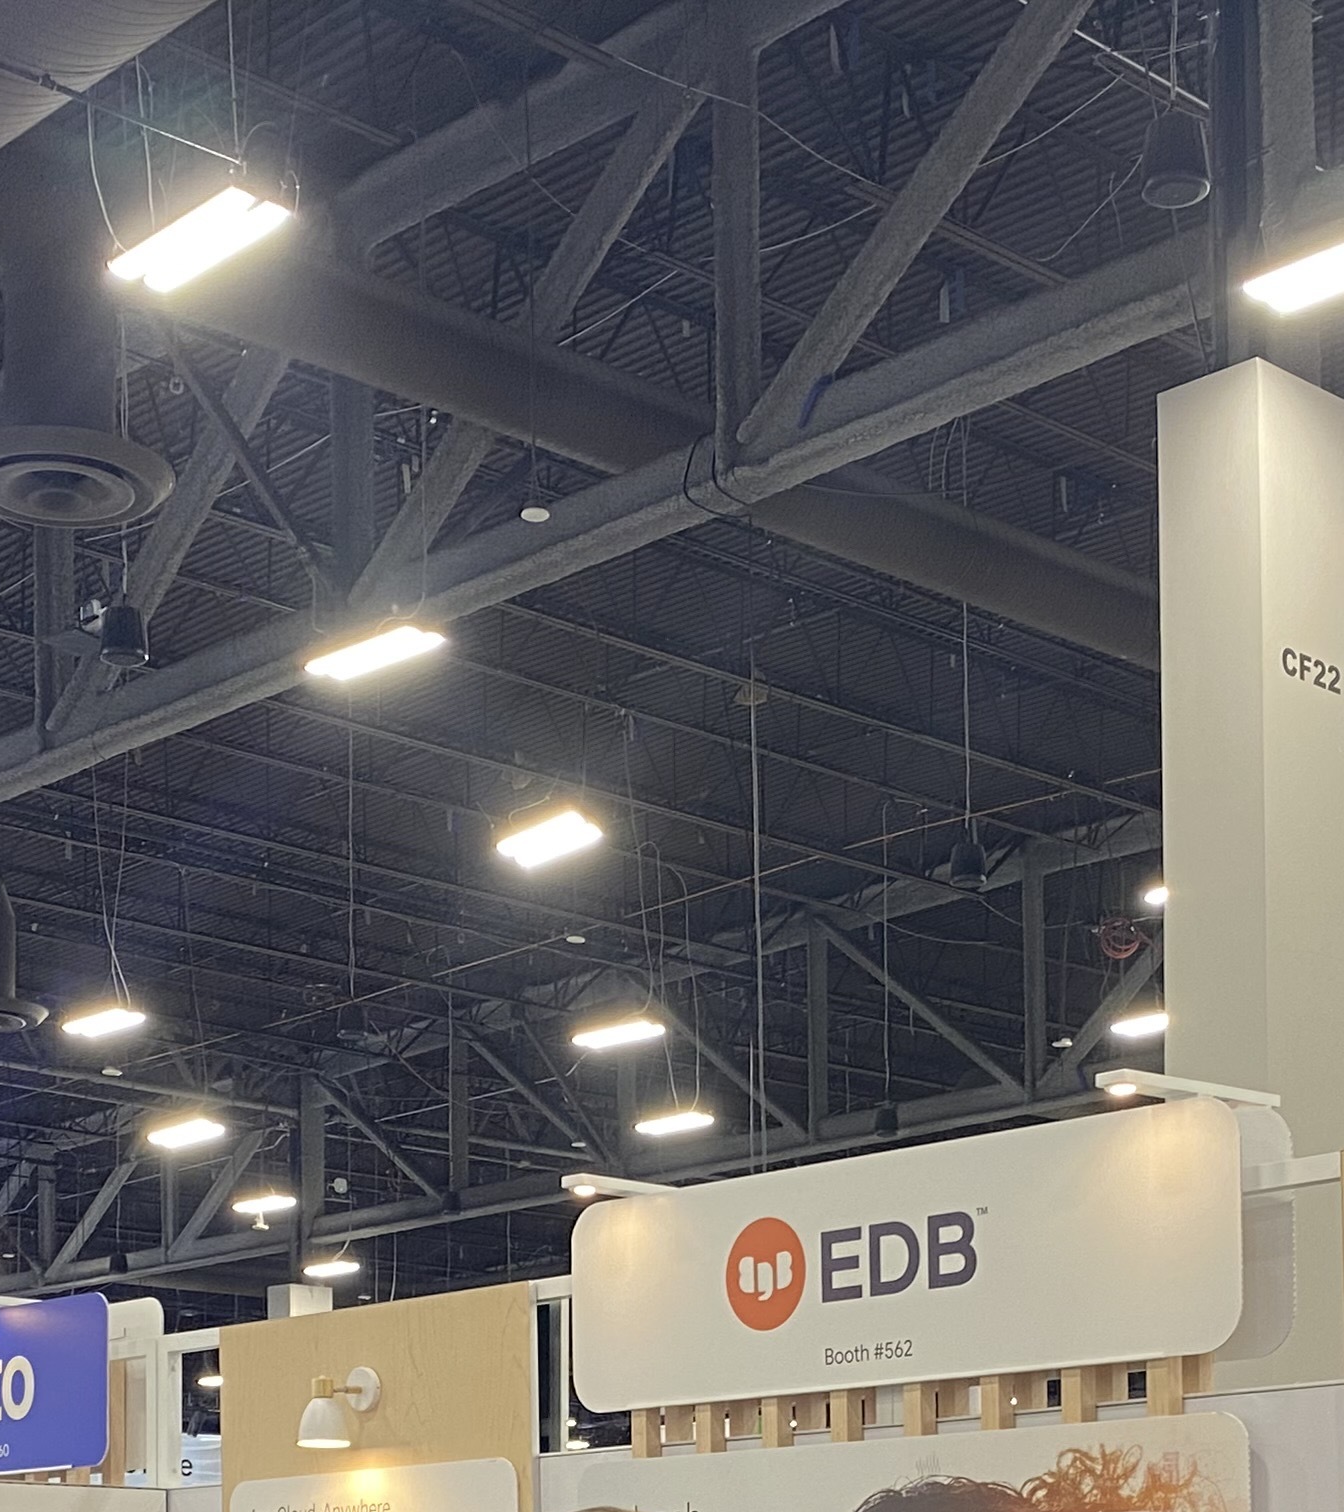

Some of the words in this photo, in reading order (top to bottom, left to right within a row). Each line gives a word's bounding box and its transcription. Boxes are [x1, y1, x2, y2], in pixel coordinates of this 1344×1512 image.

[1281, 647, 1341, 695] CF22
[821, 1211, 977, 1303] EDB
[825, 1344, 870, 1366] Booth
[874, 1340, 913, 1360] #562
